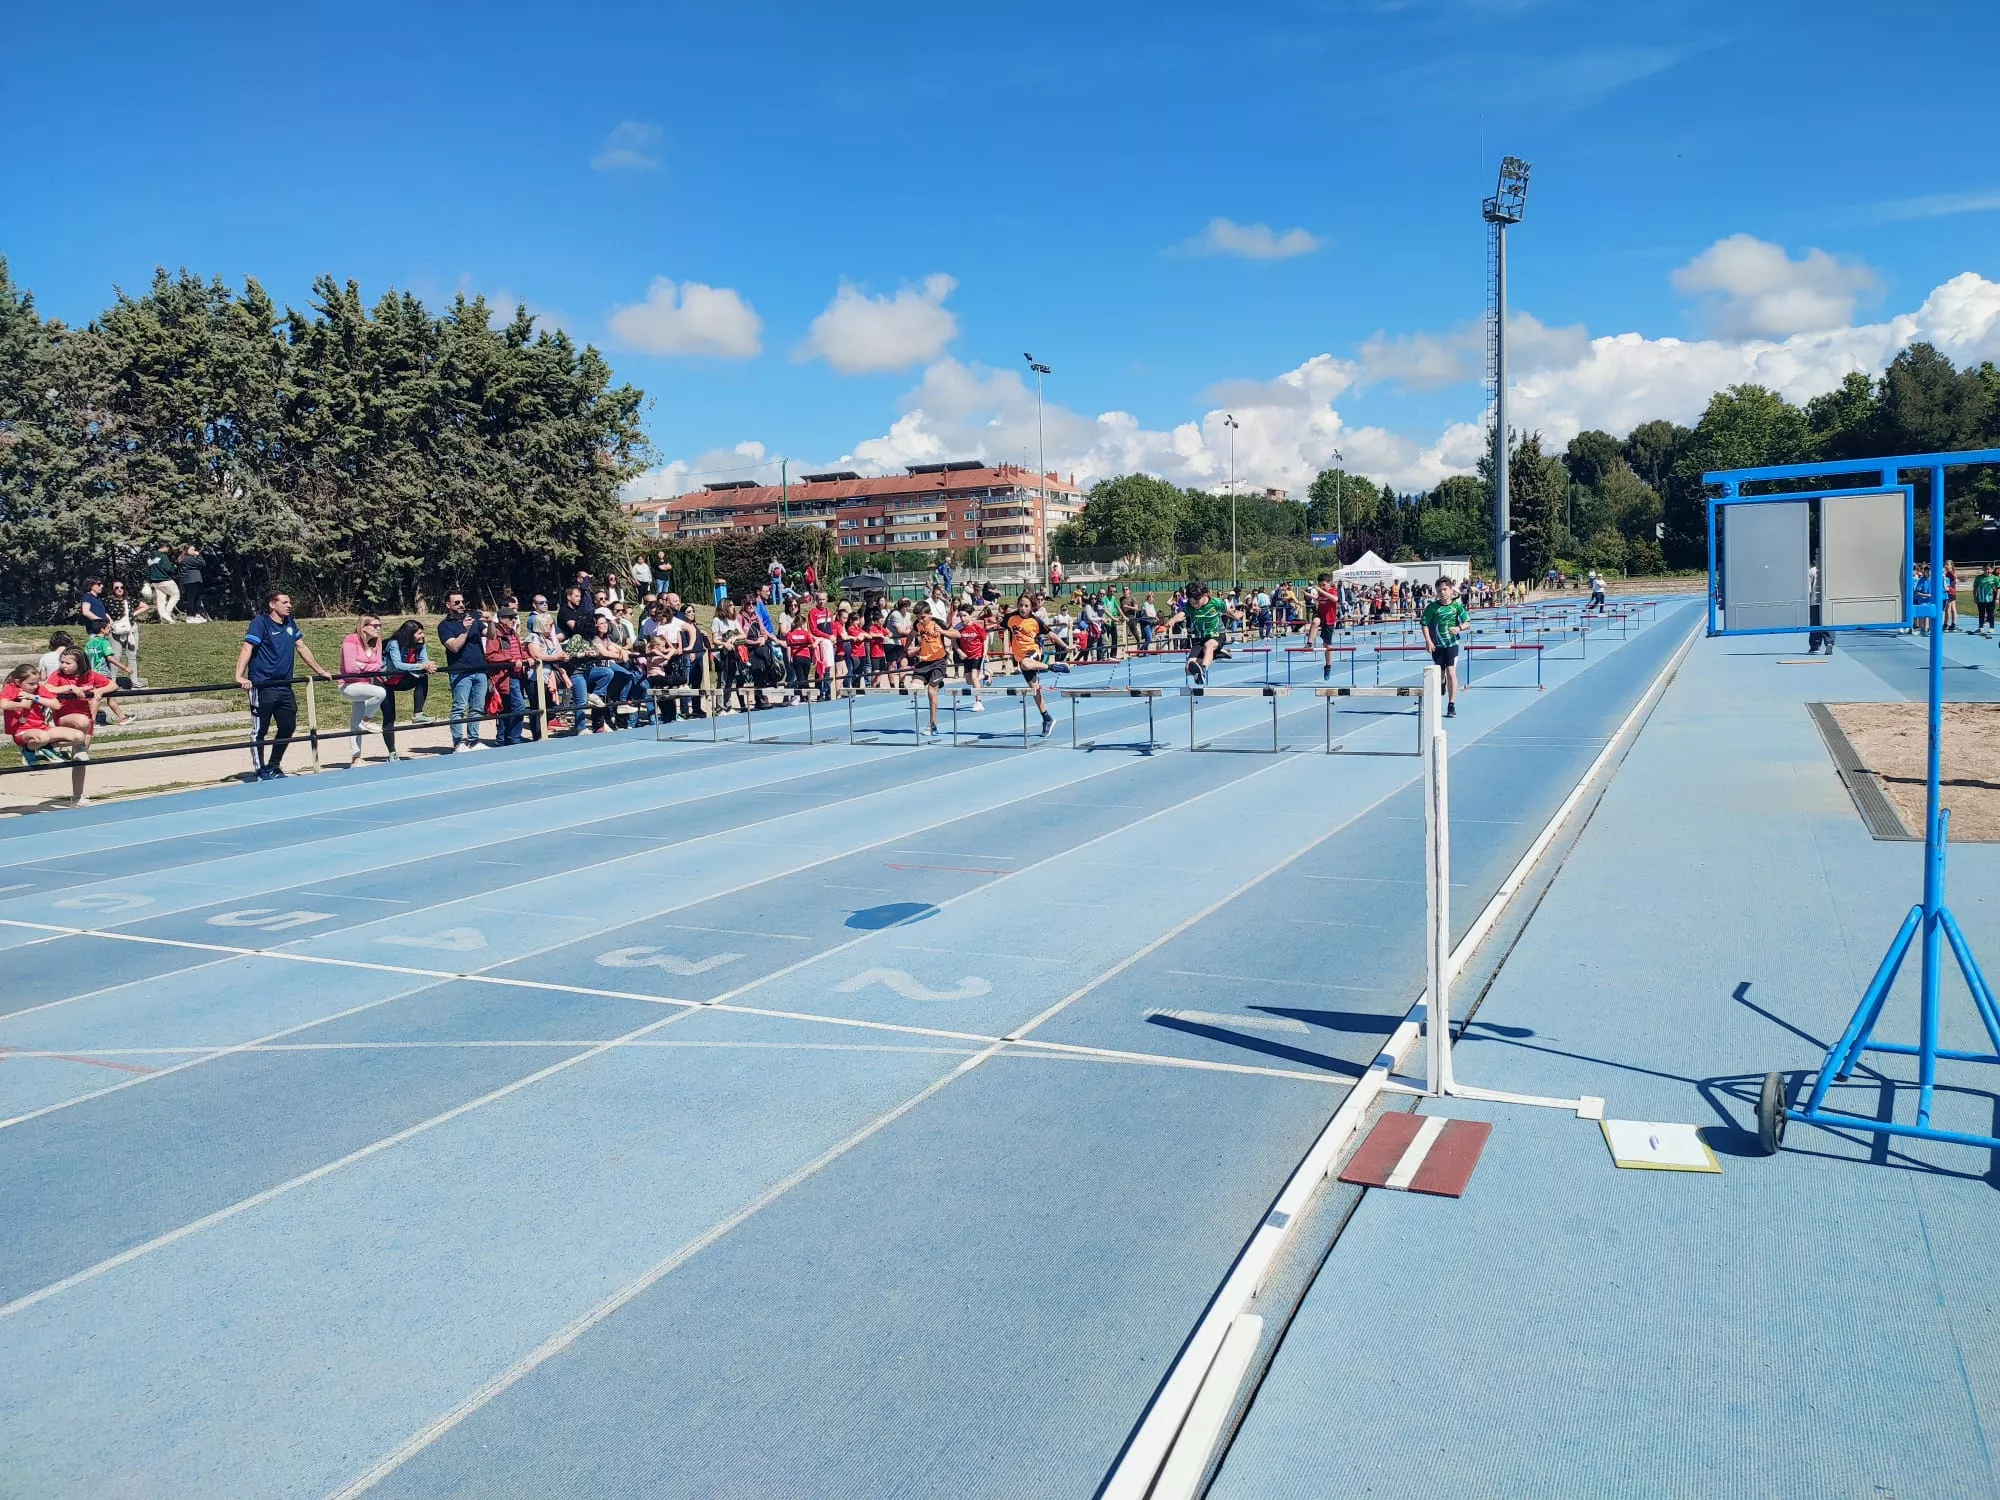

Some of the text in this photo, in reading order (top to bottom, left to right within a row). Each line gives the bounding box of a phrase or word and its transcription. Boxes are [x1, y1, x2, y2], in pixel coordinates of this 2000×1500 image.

[205, 908, 341, 932] 5
[373, 927, 489, 951] 4
[595, 945, 747, 976] 3
[832, 967, 994, 1001] 2
